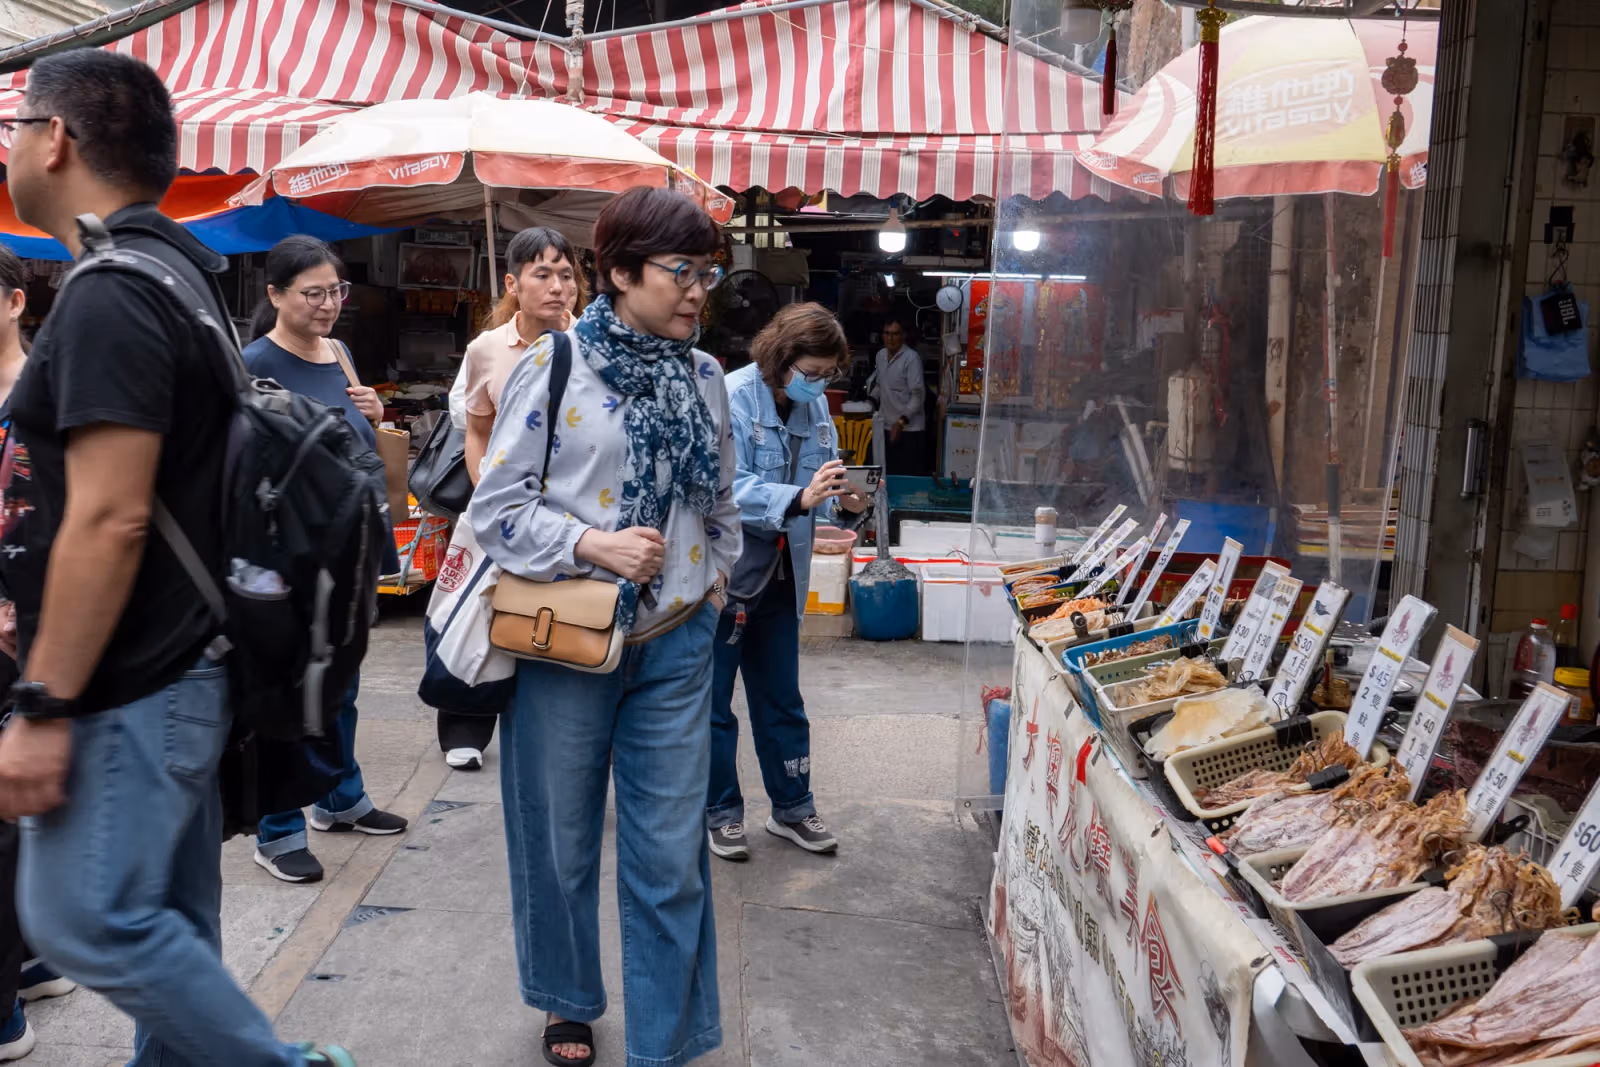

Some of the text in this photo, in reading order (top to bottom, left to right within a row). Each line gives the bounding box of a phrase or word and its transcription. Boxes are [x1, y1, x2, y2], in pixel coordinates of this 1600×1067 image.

[1223, 68, 1354, 115] 維他奶
[439, 573, 457, 589] OE'S
[442, 566, 465, 584] ADER
[1234, 624, 1250, 639] $30
[1256, 633, 1272, 648] $30
[1360, 686, 1370, 700] 2
[1560, 851, 1571, 867] 1
